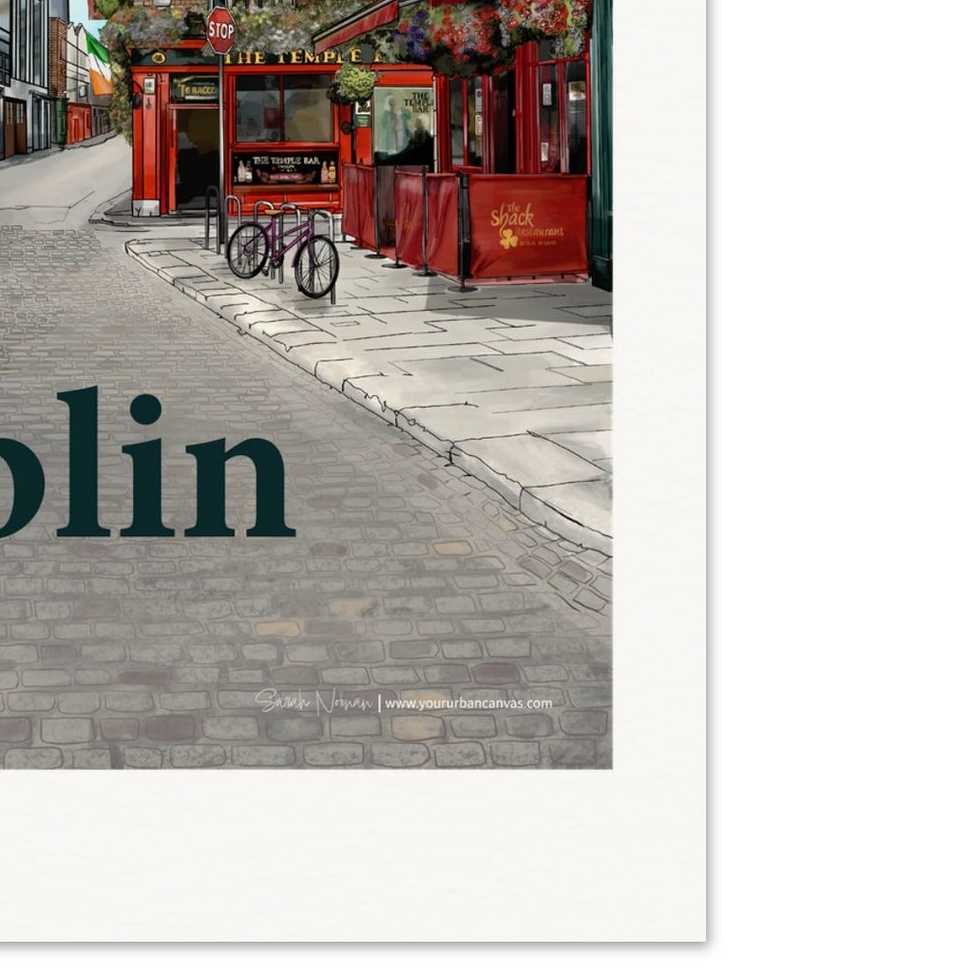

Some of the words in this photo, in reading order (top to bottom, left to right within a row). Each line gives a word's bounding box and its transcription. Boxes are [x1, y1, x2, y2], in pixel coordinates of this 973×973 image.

[208, 21, 234, 39] STOP
[303, 156, 321, 165] BAR
[490, 202, 534, 235] Shack
